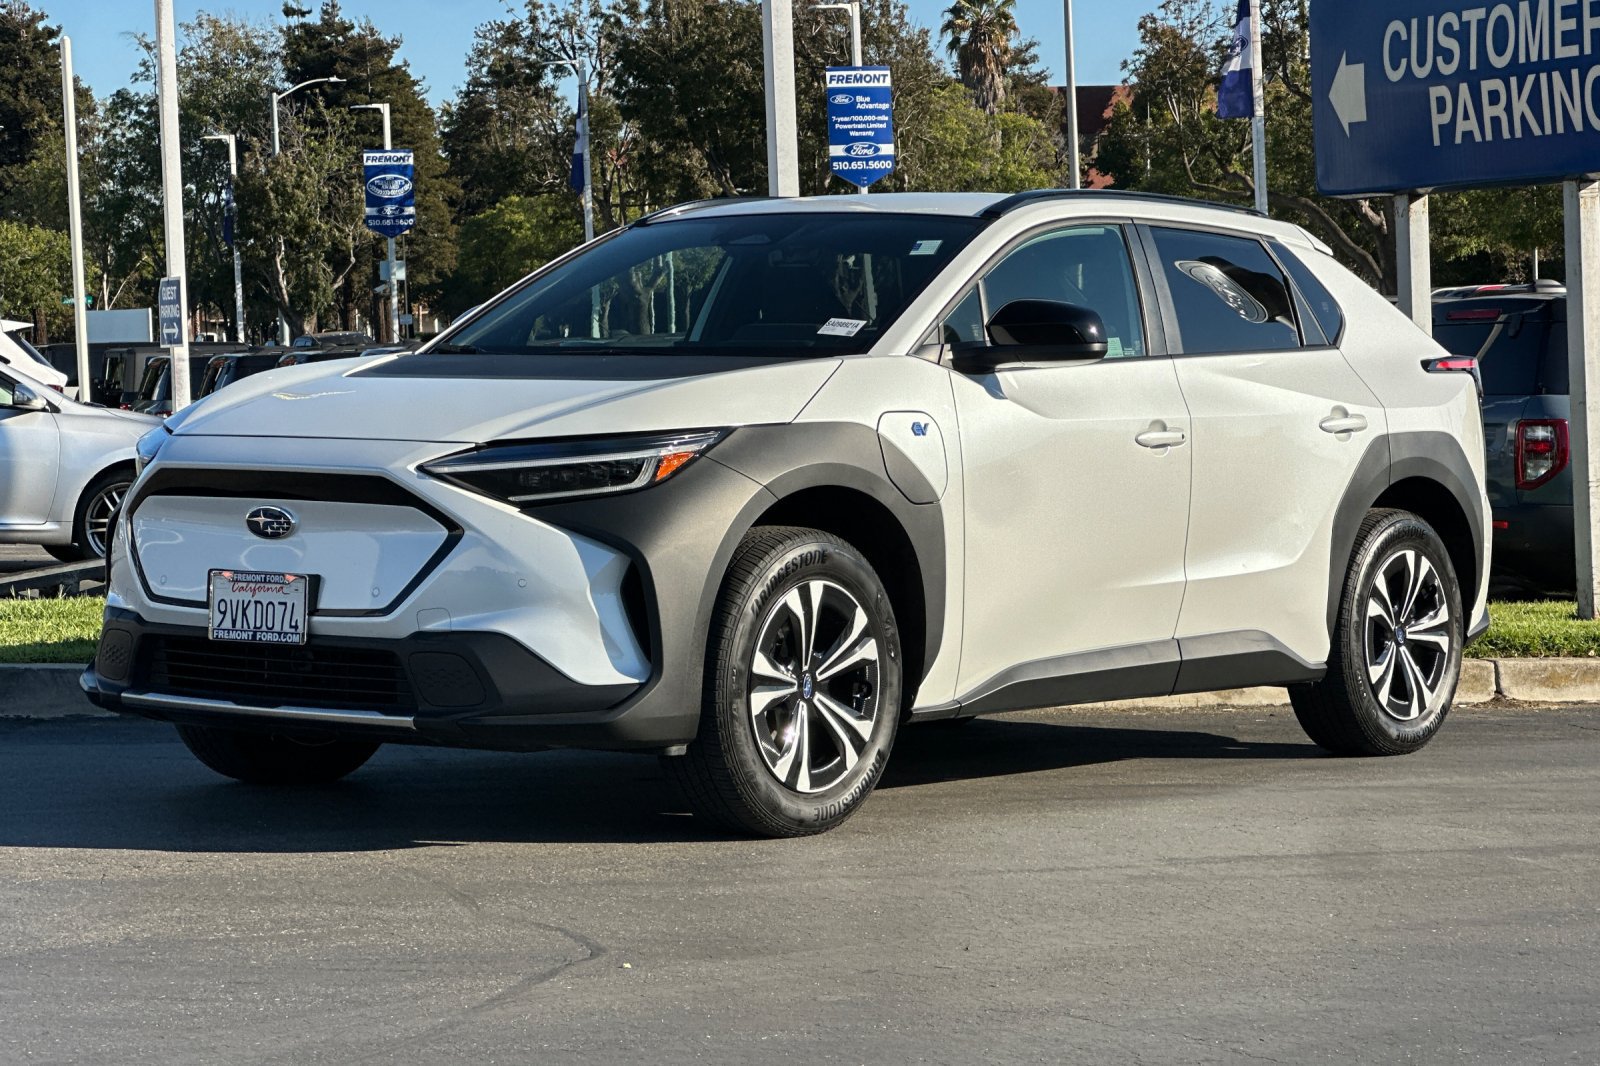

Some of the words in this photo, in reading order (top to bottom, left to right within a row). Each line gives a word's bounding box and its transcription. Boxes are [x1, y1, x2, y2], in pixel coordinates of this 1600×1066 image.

[828, 74, 888, 84] FREMONT
[850, 144, 875, 156] Ford
[832, 160, 892, 171] 510.651.5600
[162, 286, 176, 300] GUEST
[161, 304, 180, 318] PARKING
[234, 573, 266, 582] FREMONT
[266, 575, 284, 583] FORD
[232, 582, 290, 597] California
[217, 598, 299, 632] 9VKD074
[214, 630, 253, 639] FREMONT
[256, 631, 300, 643] FORD.COM
